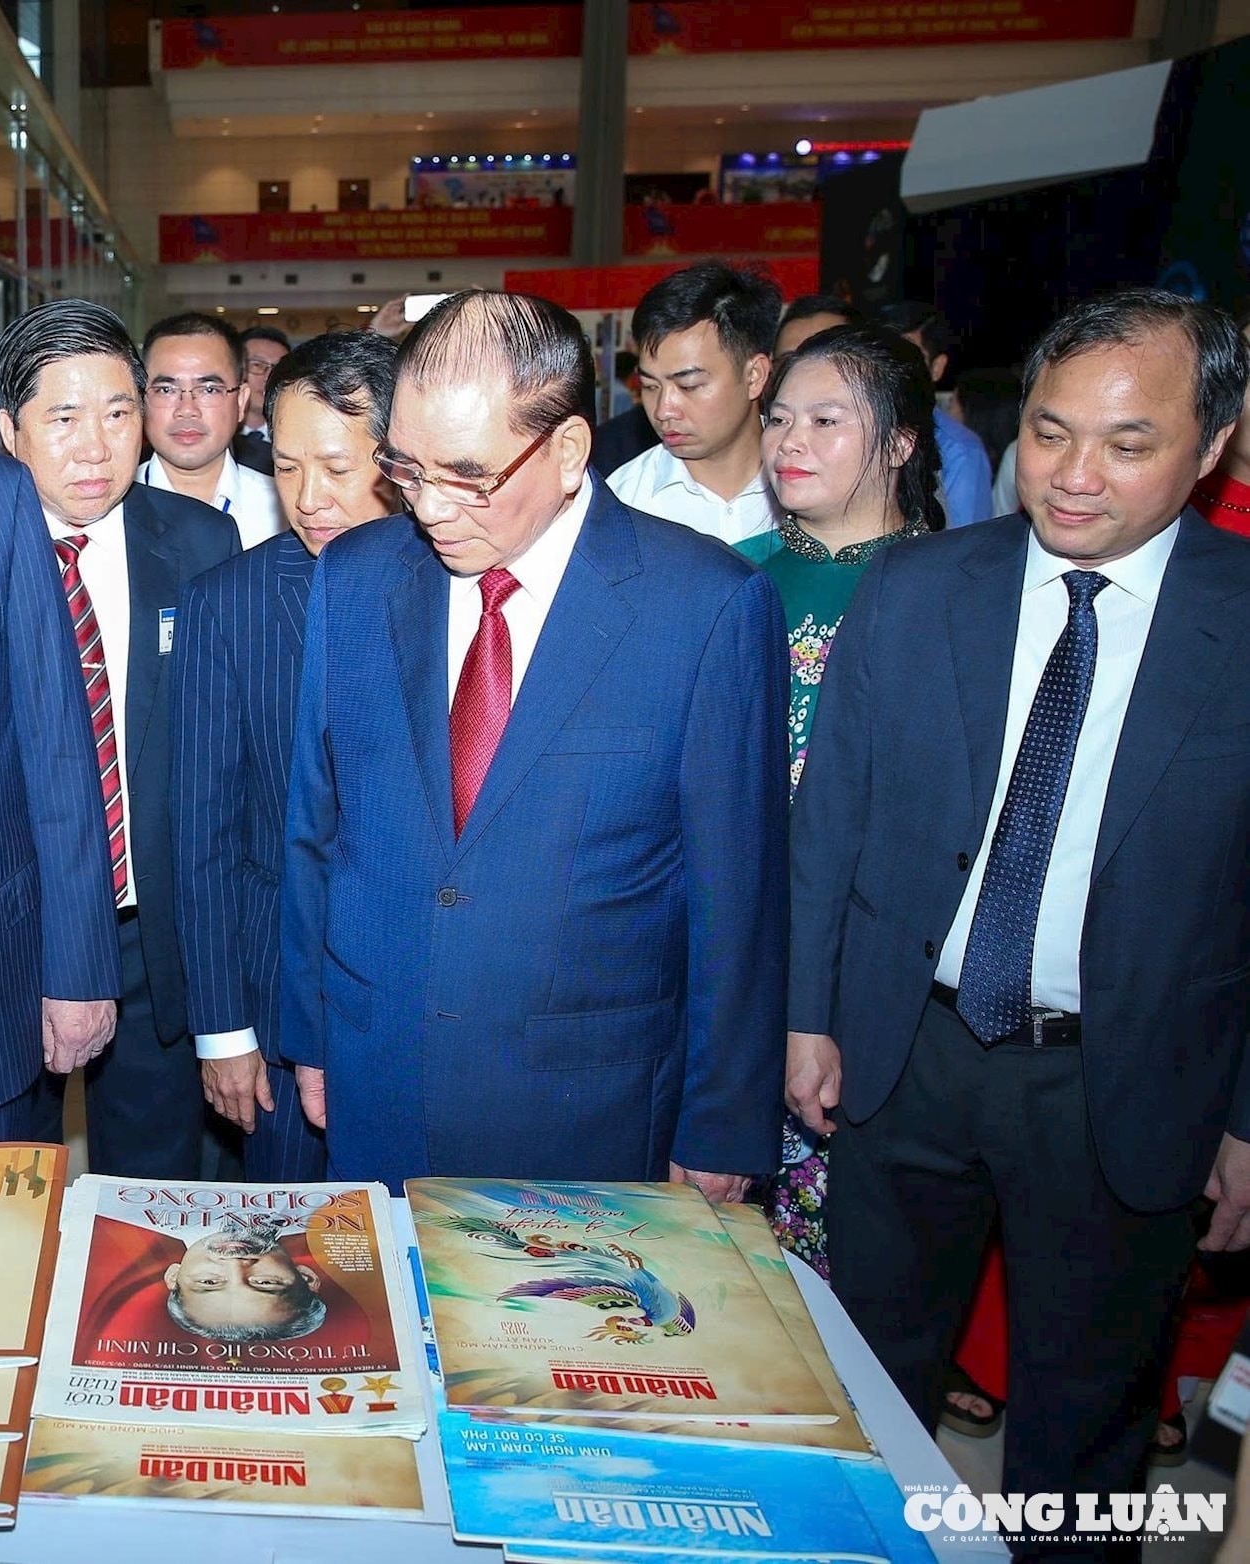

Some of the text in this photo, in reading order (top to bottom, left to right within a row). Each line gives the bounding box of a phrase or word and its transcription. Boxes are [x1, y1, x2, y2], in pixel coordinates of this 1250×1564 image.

[96, 1339, 371, 1361] TƯ TƯỞNG HỒ CHÍ MINH
[481, 1342, 507, 1351] NĂM
[550, 1345, 584, 1353] CHÚC
[68, 1376, 118, 1395] tuần
[552, 1373, 718, 1400] Nhân Dân
[64, 1391, 115, 1409] cuối
[118, 1387, 311, 1415] Nhân Dân
[150, 1427, 185, 1436] CHÚC
[494, 1430, 520, 1442] ĐỘT
[578, 1446, 612, 1459] DÁM
[139, 1459, 307, 1487] Nhân Dân
[552, 1498, 773, 1537] Nhân Dân
